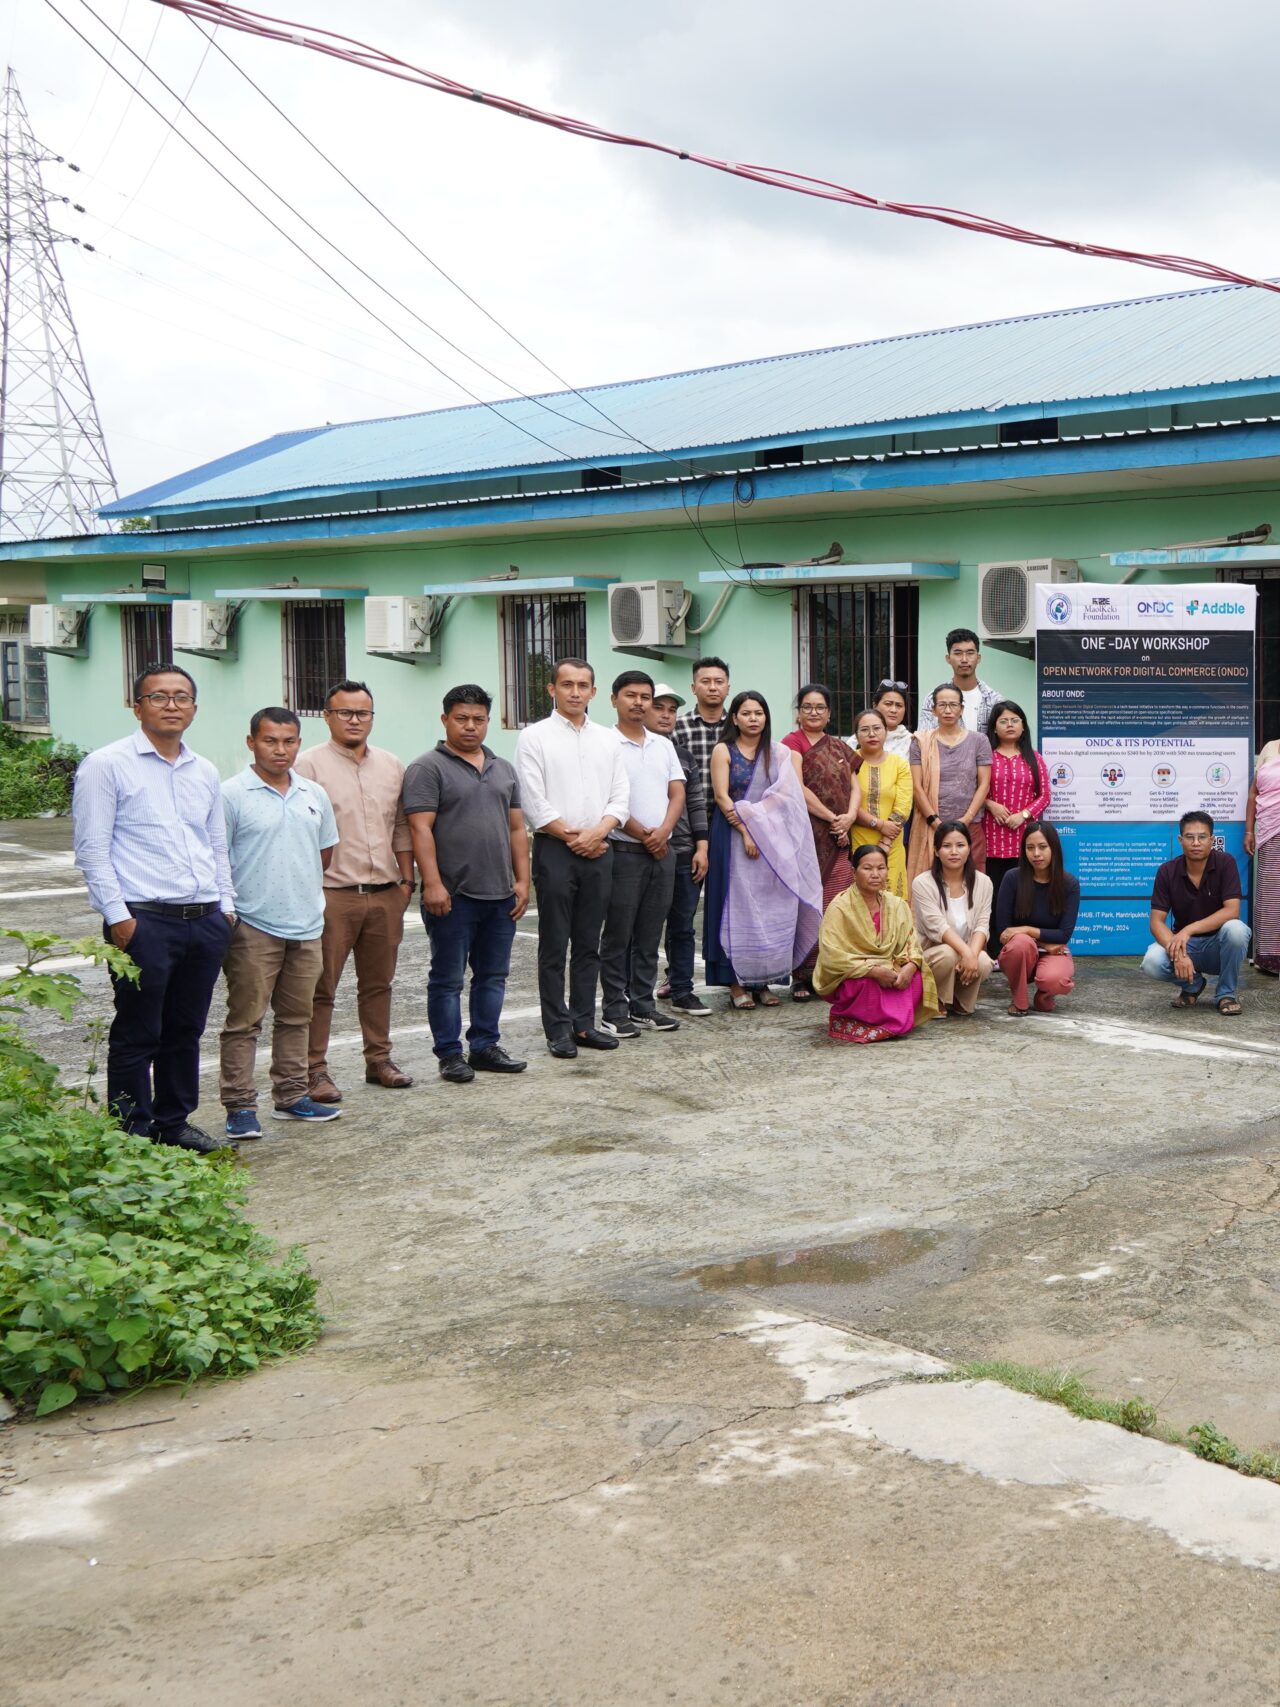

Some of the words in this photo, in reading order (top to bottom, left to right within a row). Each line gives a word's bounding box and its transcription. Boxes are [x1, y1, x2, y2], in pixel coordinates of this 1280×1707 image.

[1137, 602, 1174, 613] ONDC
[1201, 602, 1245, 614] Addble
[1081, 637, 1106, 650] ONE
[1141, 637, 1210, 650] WORKSHOP
[1042, 666, 1067, 676] OPEN
[1068, 666, 1112, 676] NETWORK
[1113, 666, 1131, 676] FOR
[1133, 666, 1166, 677] DIGITAL
[1168, 666, 1217, 677] COMMERCE
[1217, 666, 1249, 677] (ONDC)
[1042, 690, 1065, 698] ABOUT
[1066, 690, 1085, 698] ONDC
[1085, 738, 1114, 747] ONDC
[1115, 738, 1122, 747] &
[1124, 738, 1140, 747] ITS
[1142, 738, 1195, 747] POTENTIAL
